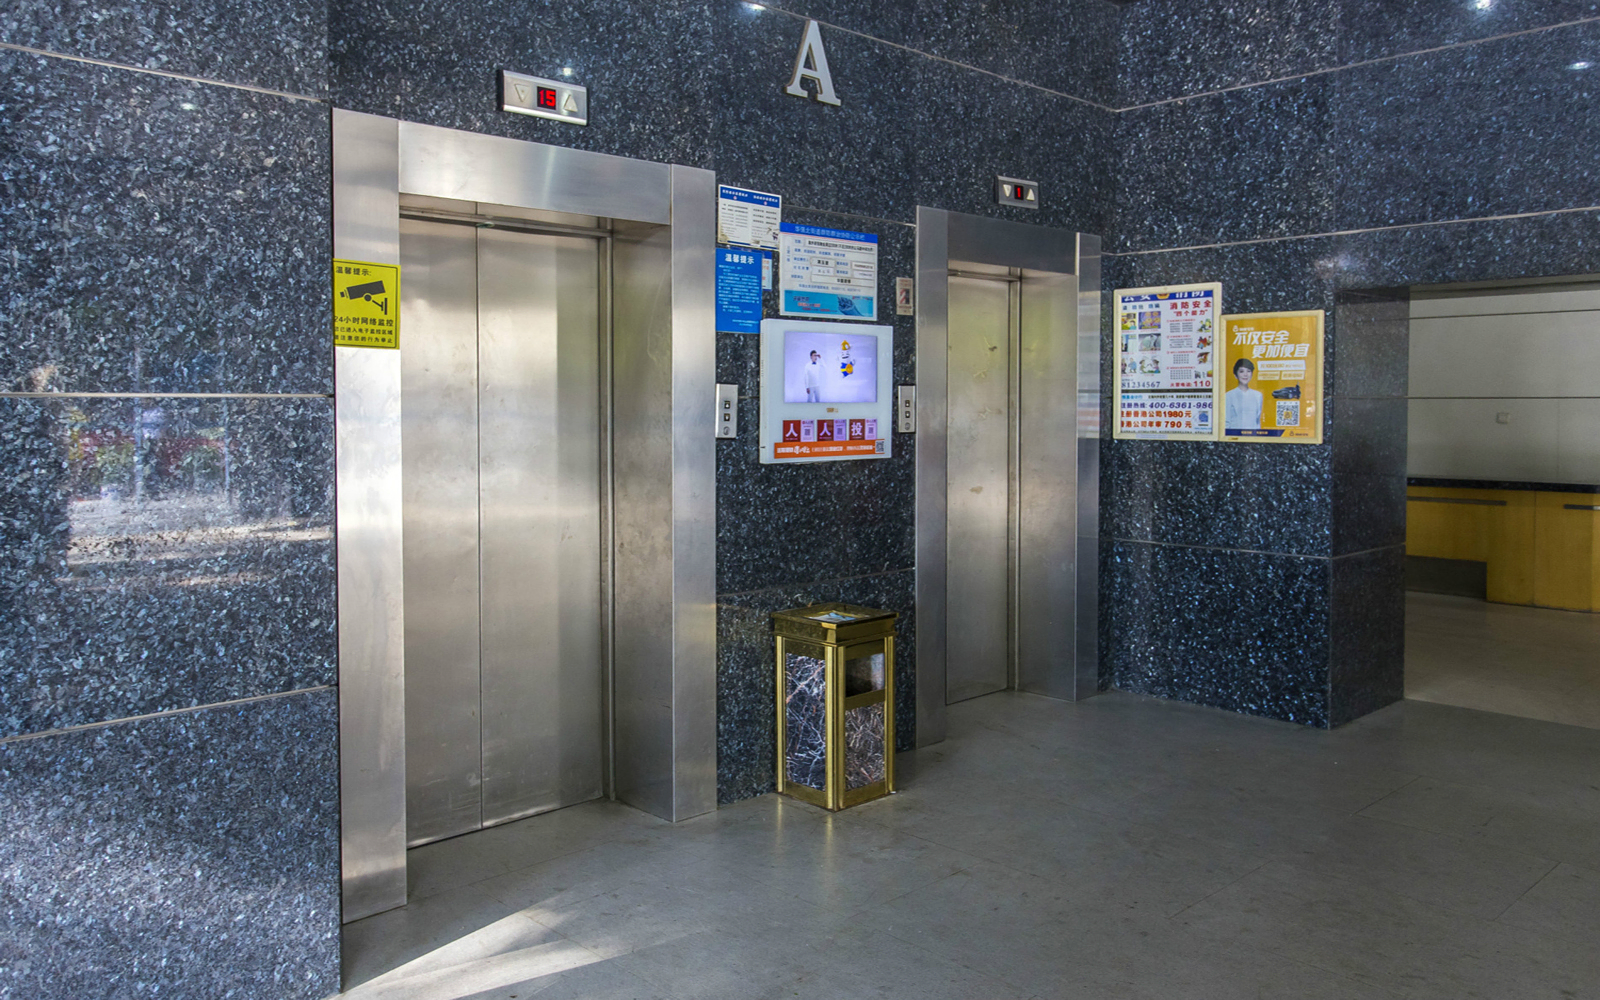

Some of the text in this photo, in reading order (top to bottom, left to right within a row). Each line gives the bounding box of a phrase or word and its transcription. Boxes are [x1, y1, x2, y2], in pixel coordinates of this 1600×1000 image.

[784, 19, 841, 106] A
[539, 89, 556, 107] 15
[724, 253, 755, 265] 温馨提示
[1170, 300, 1212, 310] 消防安全
[335, 316, 393, 327] 24小时网络监控
[1233, 330, 1290, 345] 不仅安全
[1252, 343, 1310, 358] 更加便宜
[785, 422, 798, 438] 人
[819, 422, 831, 437] 人
[851, 421, 863, 437] 投
